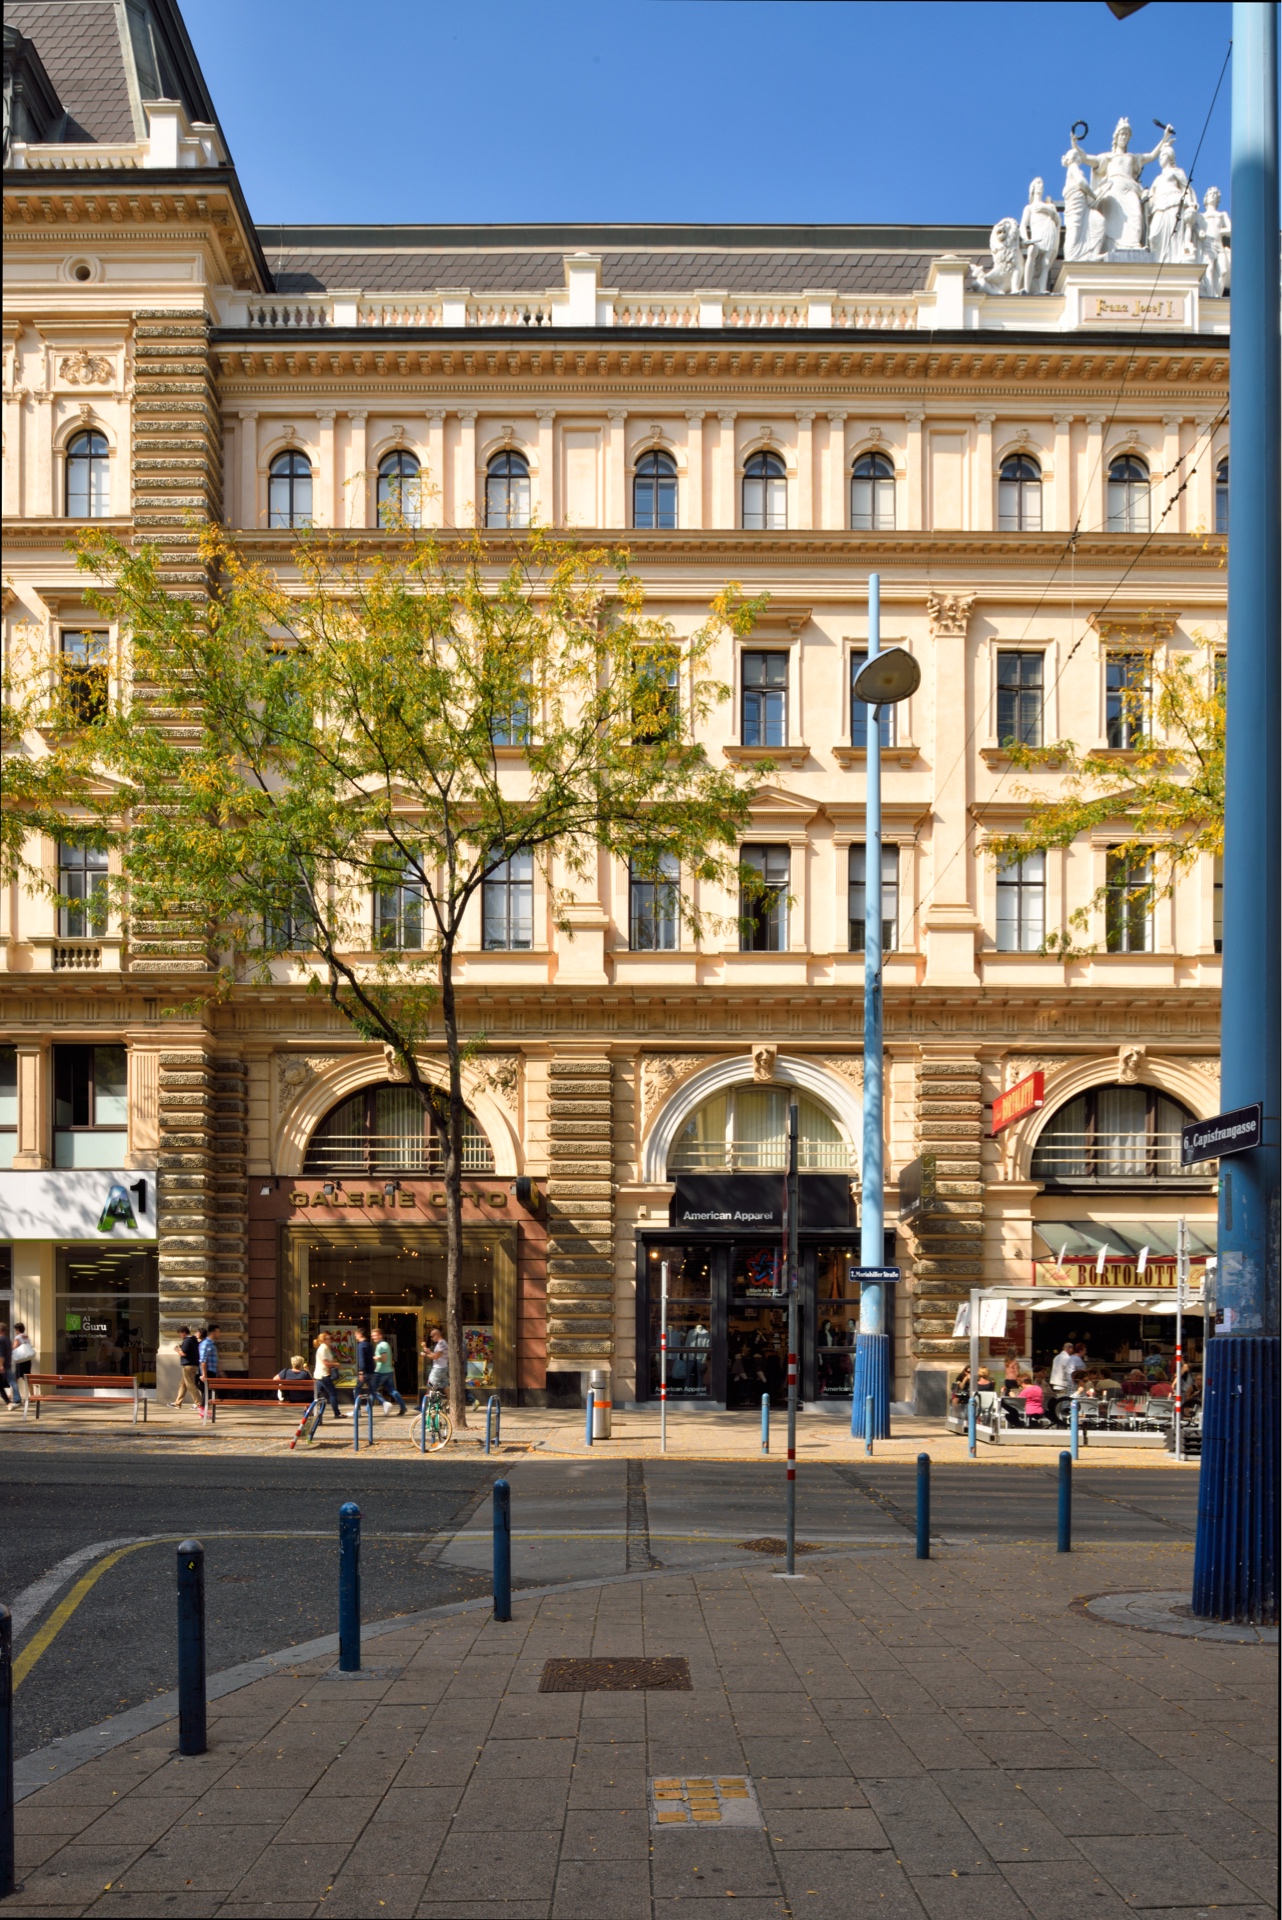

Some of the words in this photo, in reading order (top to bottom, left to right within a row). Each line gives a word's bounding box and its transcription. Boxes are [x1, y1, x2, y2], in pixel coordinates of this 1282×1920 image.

[1096, 299, 1128, 317] Franz
[1193, 1120, 1256, 1148] Capistrangasse
[97, 1178, 146, 1232] A1
[290, 1190, 414, 1208] GALERIE
[683, 1211, 732, 1220] American
[733, 1211, 773, 1222] Apparel
[1077, 1264, 1177, 1286] BORTOLOTT
[82, 1322, 107, 1331] Guru
